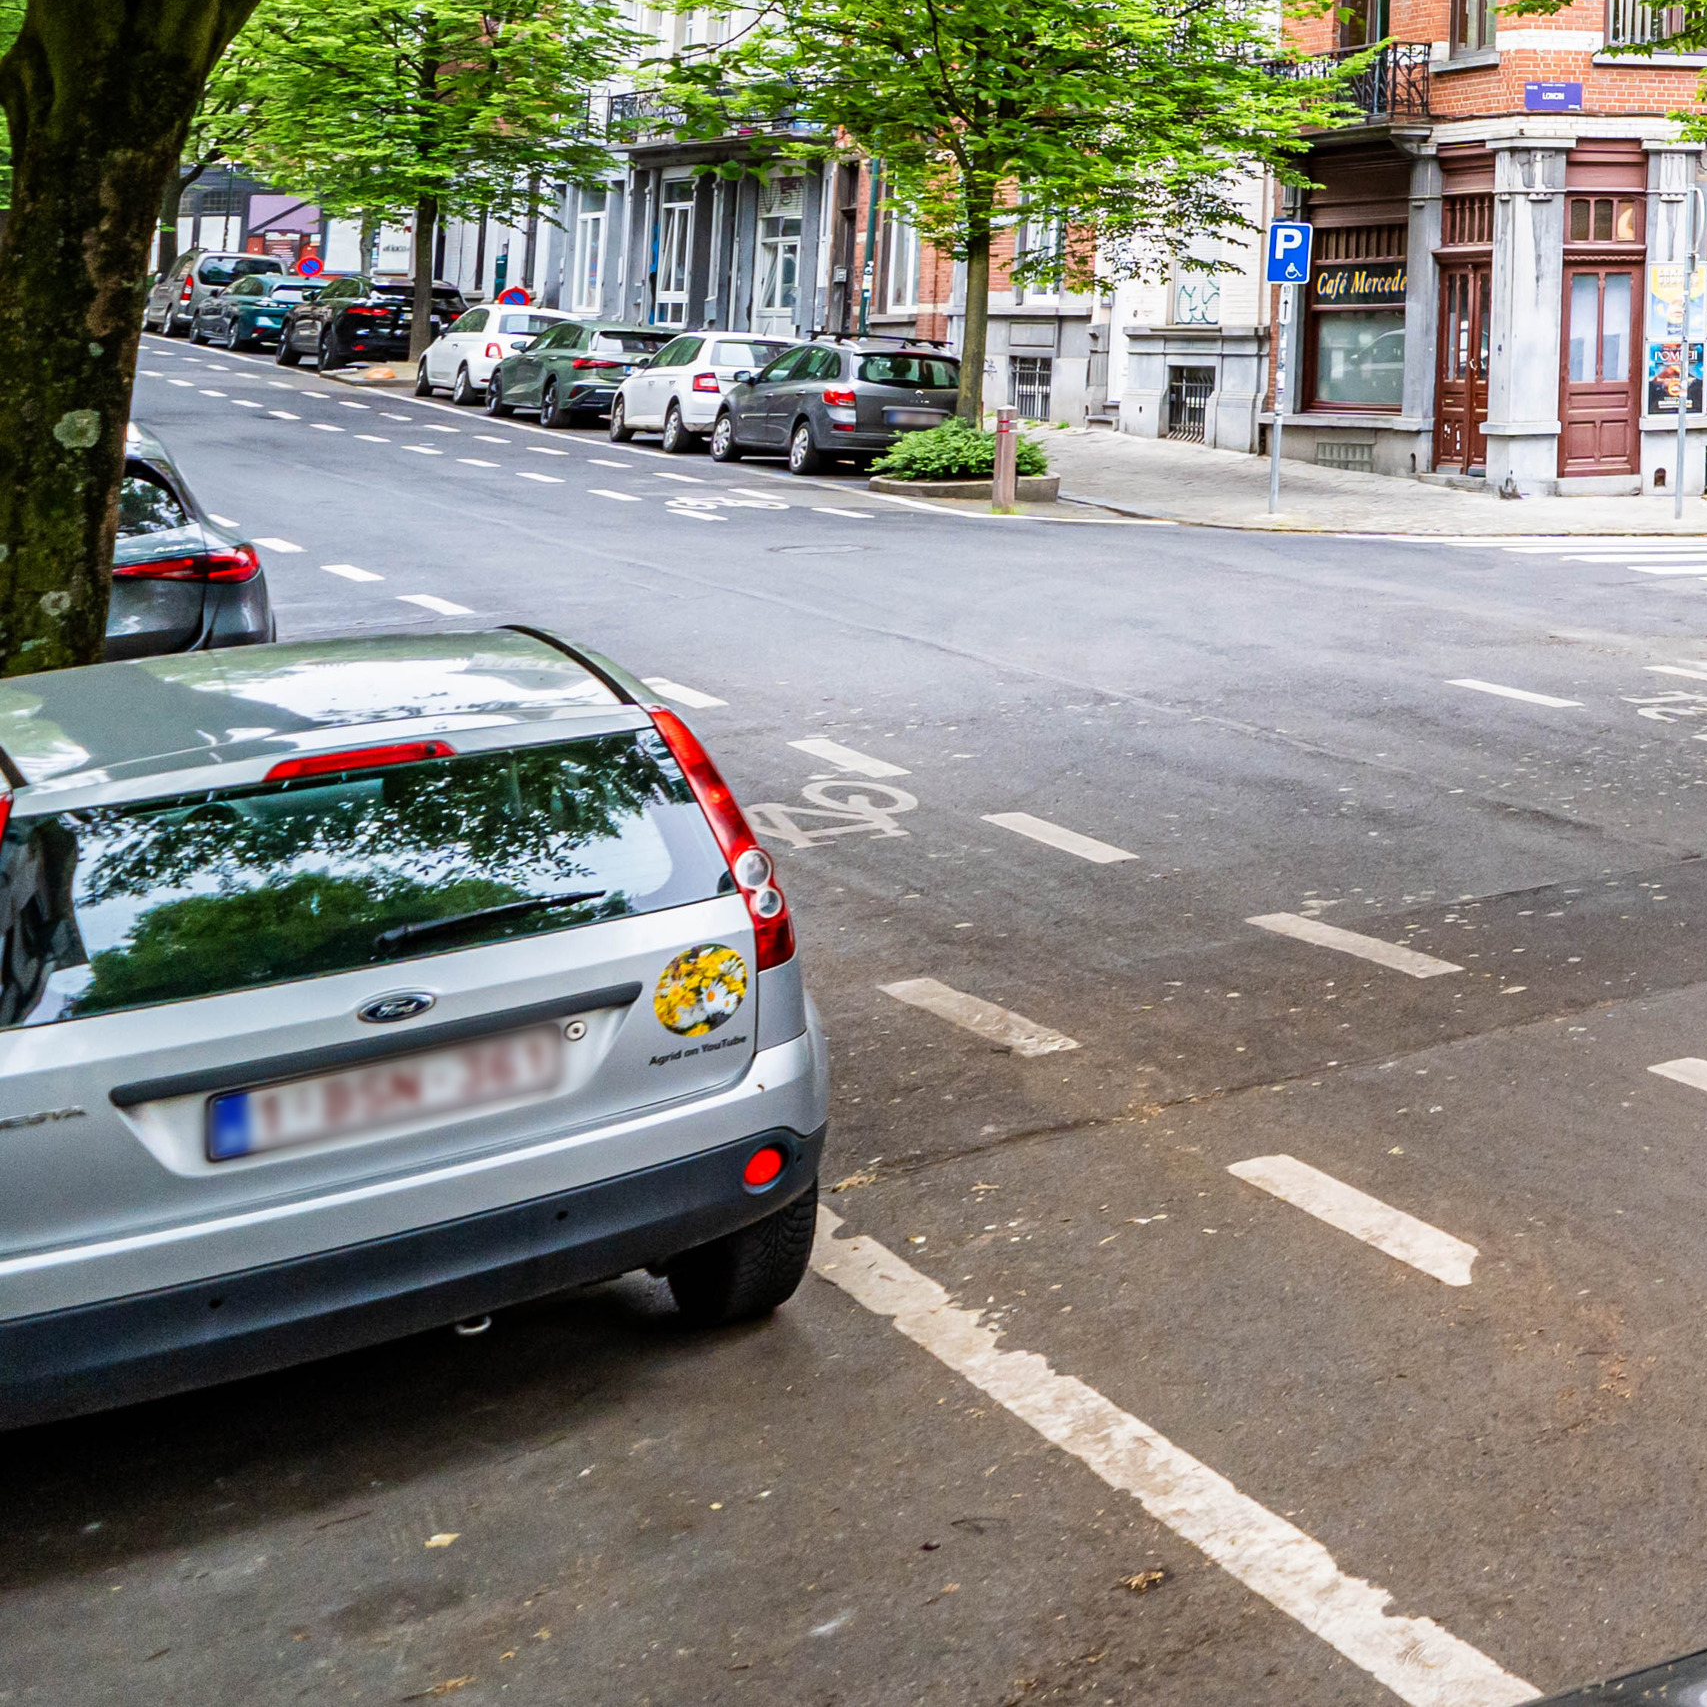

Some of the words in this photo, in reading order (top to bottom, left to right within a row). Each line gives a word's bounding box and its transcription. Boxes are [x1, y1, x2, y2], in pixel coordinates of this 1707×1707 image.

[1274, 227, 1303, 260] P
[1316, 271, 1348, 300] Café
[1350, 268, 1408, 294] Mercede
[1654, 350, 1698, 362] POMII
[376, 999, 418, 1018] Ford
[648, 1050, 682, 1067] Agrid
[683, 1047, 699, 1058] on
[701, 1035, 747, 1053] YouTube
